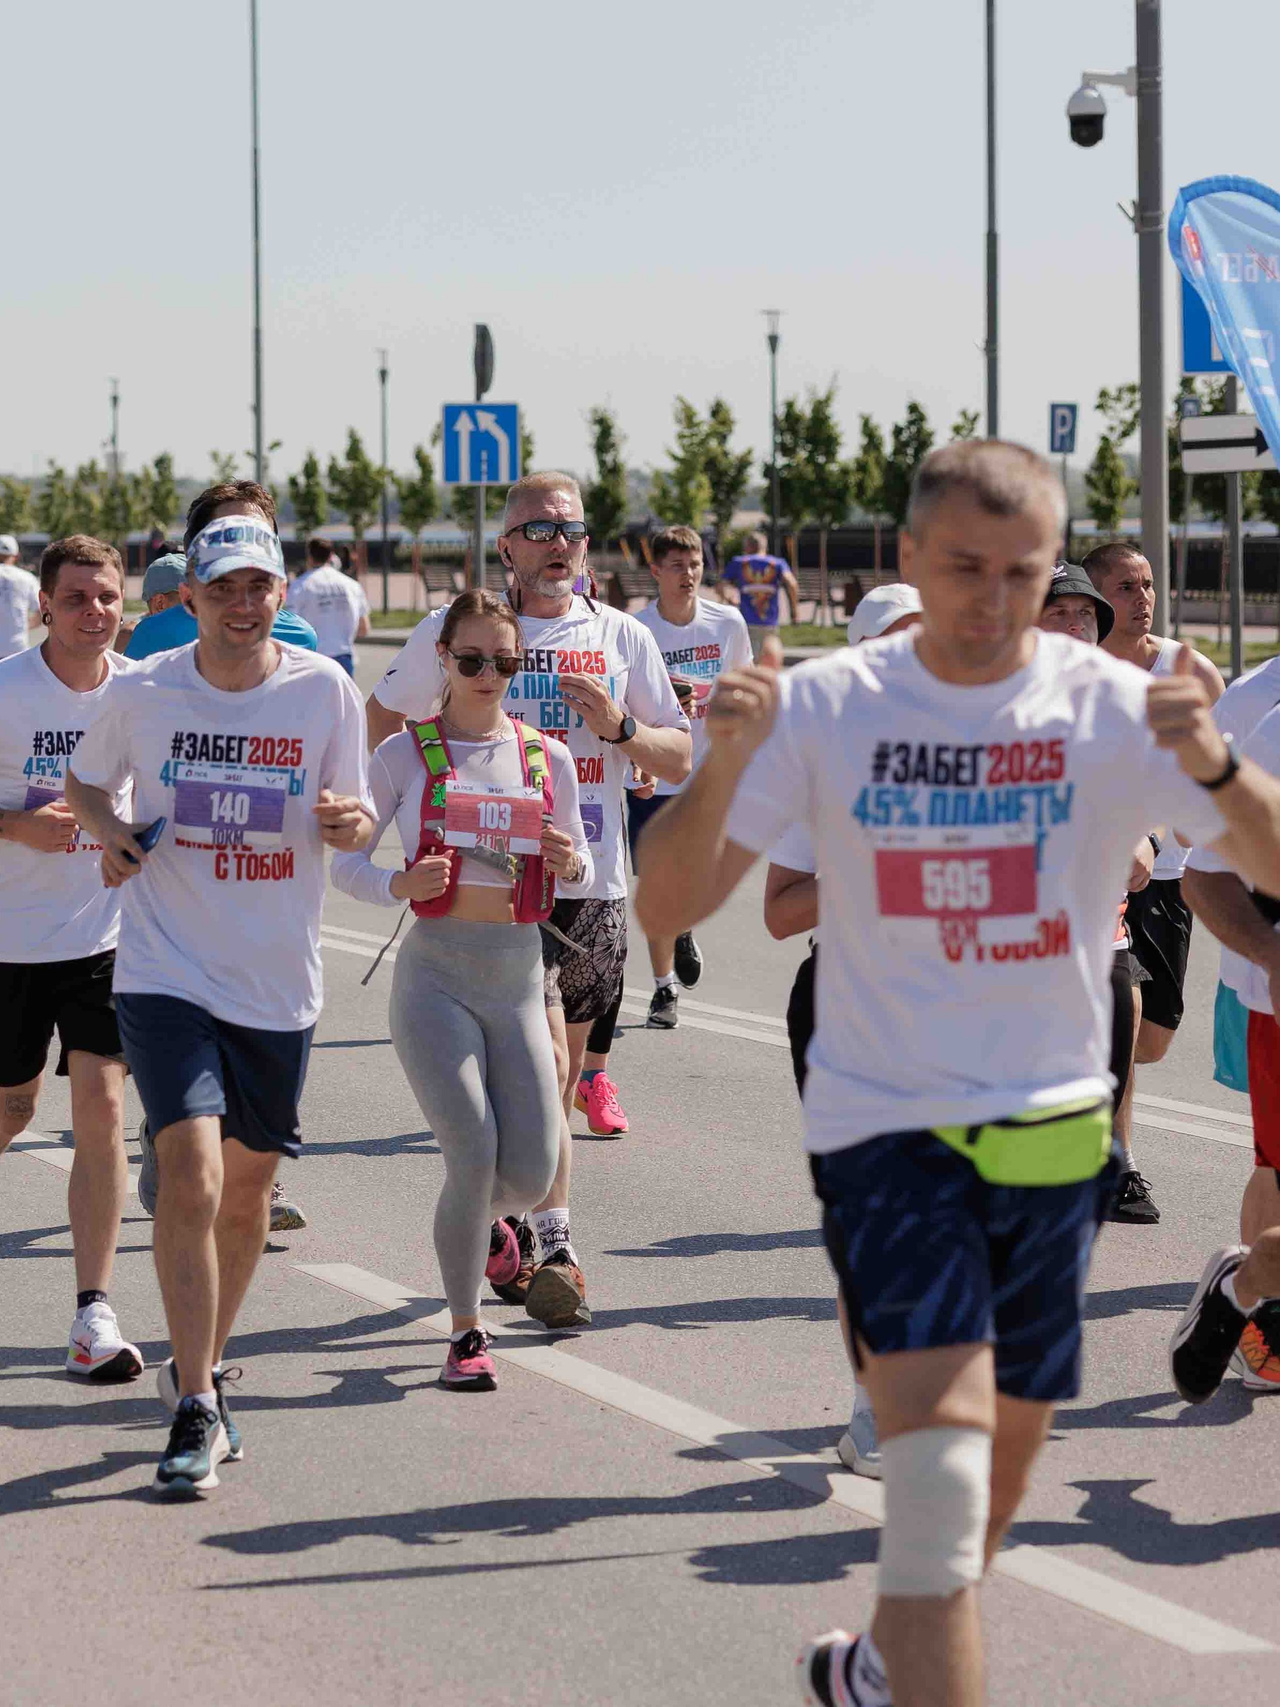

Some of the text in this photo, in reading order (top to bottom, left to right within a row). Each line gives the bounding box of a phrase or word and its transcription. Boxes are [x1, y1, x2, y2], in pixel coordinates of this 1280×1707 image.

[1054, 407, 1071, 450] P
[519, 649, 607, 675] БЕГ2025
[171, 731, 304, 767] #ЗАБЕГ2025
[872, 739, 1066, 786] #ЗАБЕГ2025
[209, 791, 251, 825] 140
[476, 800, 512, 831] 103
[215, 847, 295, 881] С ТОБОЙ
[921, 859, 992, 910] 595
